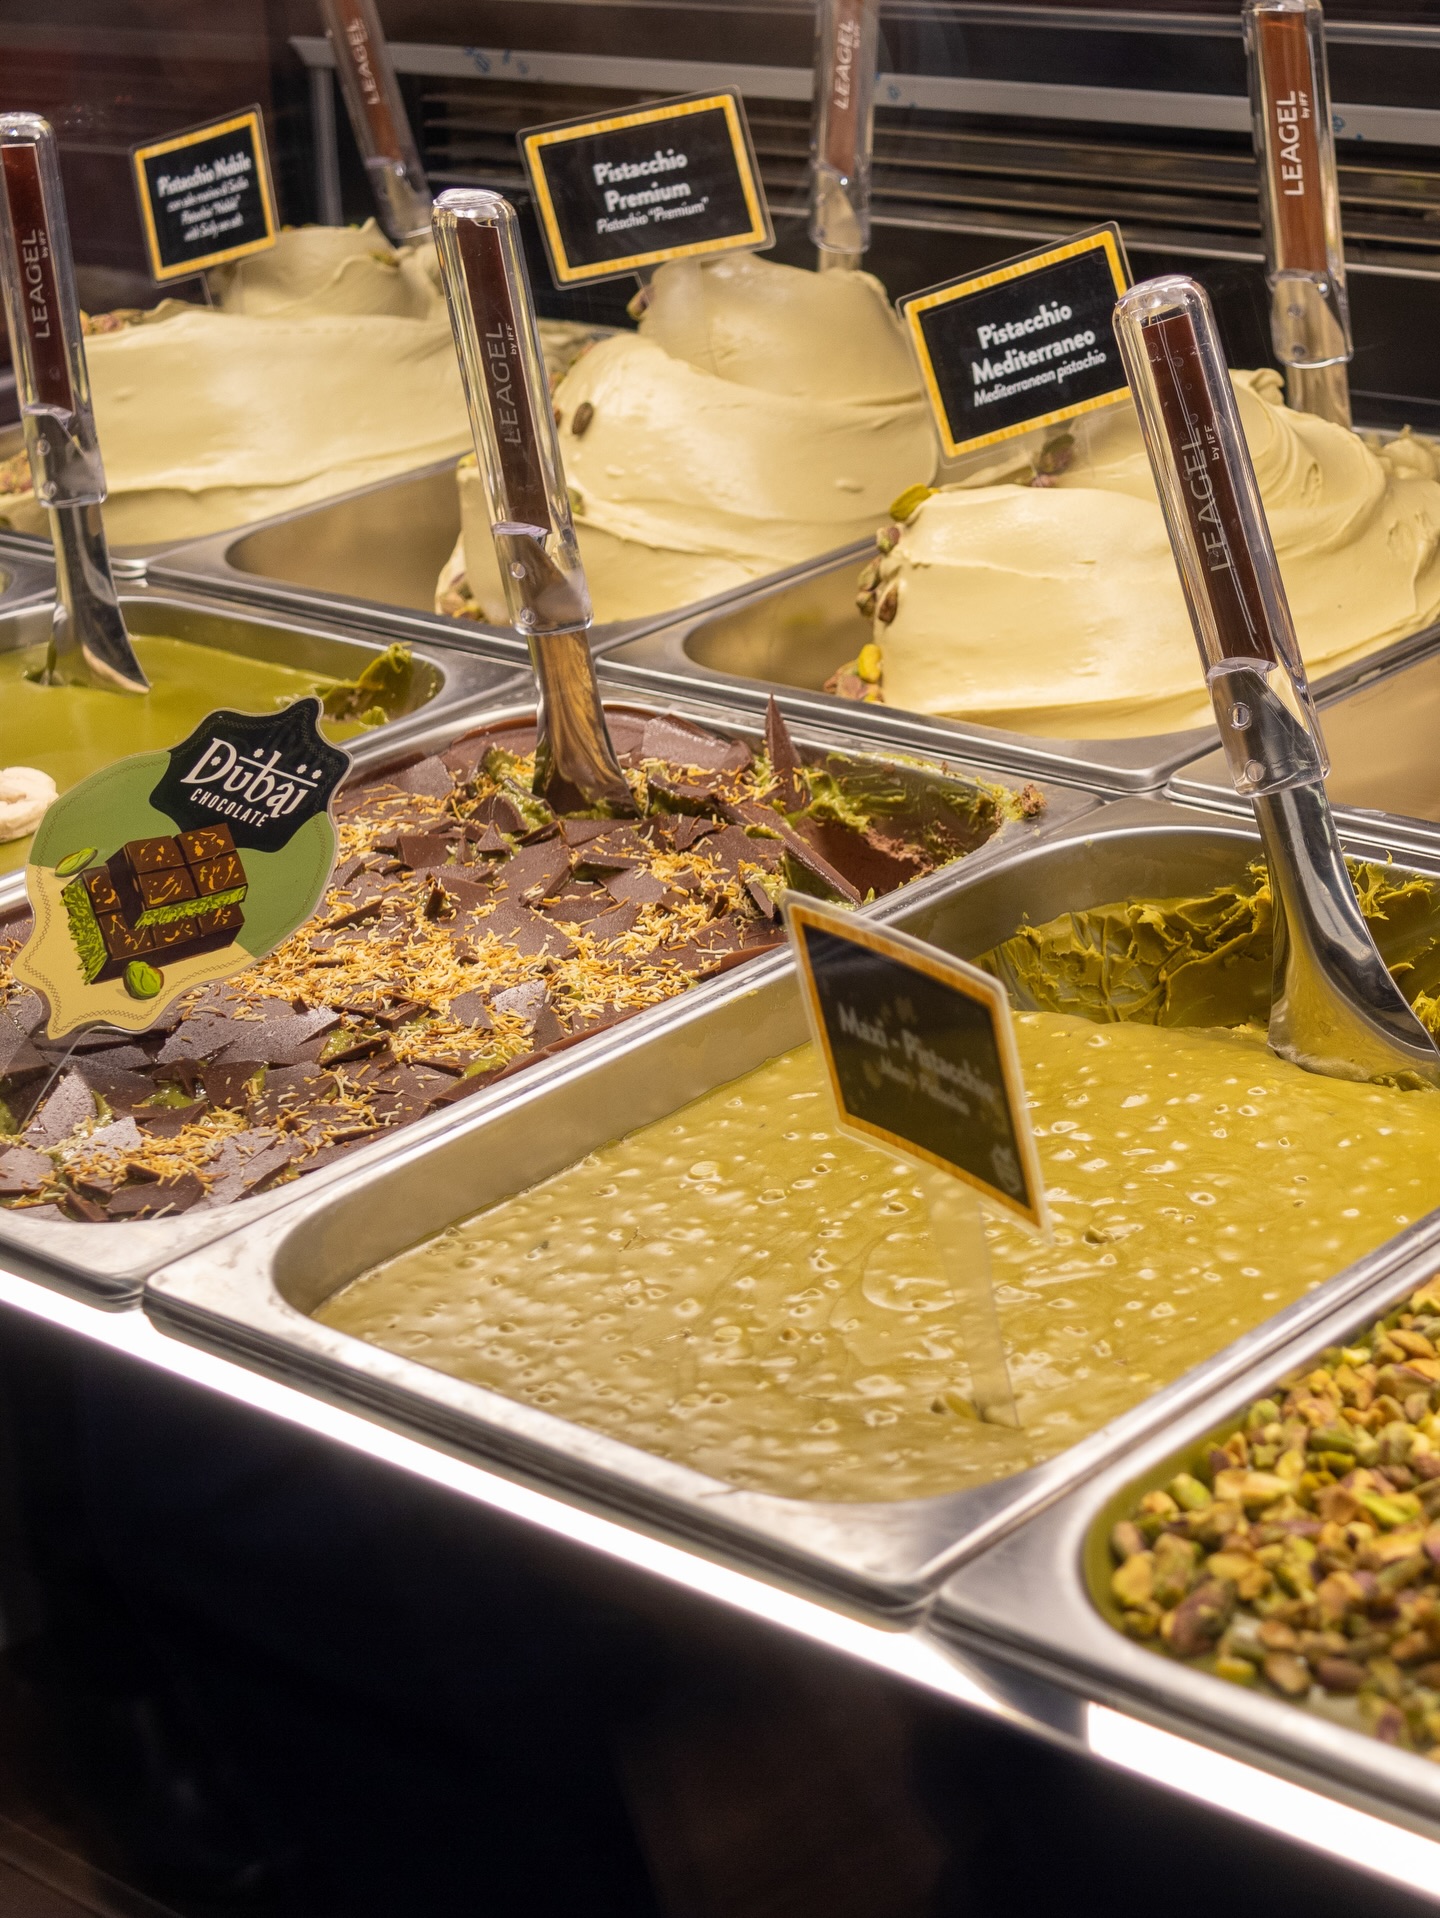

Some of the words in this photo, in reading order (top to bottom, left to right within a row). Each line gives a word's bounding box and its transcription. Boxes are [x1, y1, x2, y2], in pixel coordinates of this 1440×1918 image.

[346, 18, 380, 105] LEAGEL
[833, 20, 854, 110] LEAGEL
[1298, 90, 1309, 107] IFF
[1301, 107, 1311, 119] by
[1276, 90, 1304, 195] LEAGEL
[157, 164, 215, 198] Pistacchio
[213, 151, 252, 180] Nobile
[593, 148, 688, 185] Pistacchio
[603, 181, 692, 213] Premium
[596, 211, 649, 235] Pistachio
[21, 228, 51, 338] LEAGEL
[506, 322, 515, 340] IFF
[510, 342, 519, 355] by
[977, 301, 1073, 350] Pistacchio
[971, 330, 1096, 386] Mediterraneo
[973, 370, 1057, 408] Mediterranean
[1056, 349, 1107, 385] pistachio
[485, 322, 522, 444] LEAGEL
[1204, 424, 1217, 446] IFF
[1211, 447, 1221, 461] by
[1181, 427, 1231, 572] LEAGEL
[180, 737, 323, 819] Dubai
[189, 788, 269, 828] CHOCOLATE
